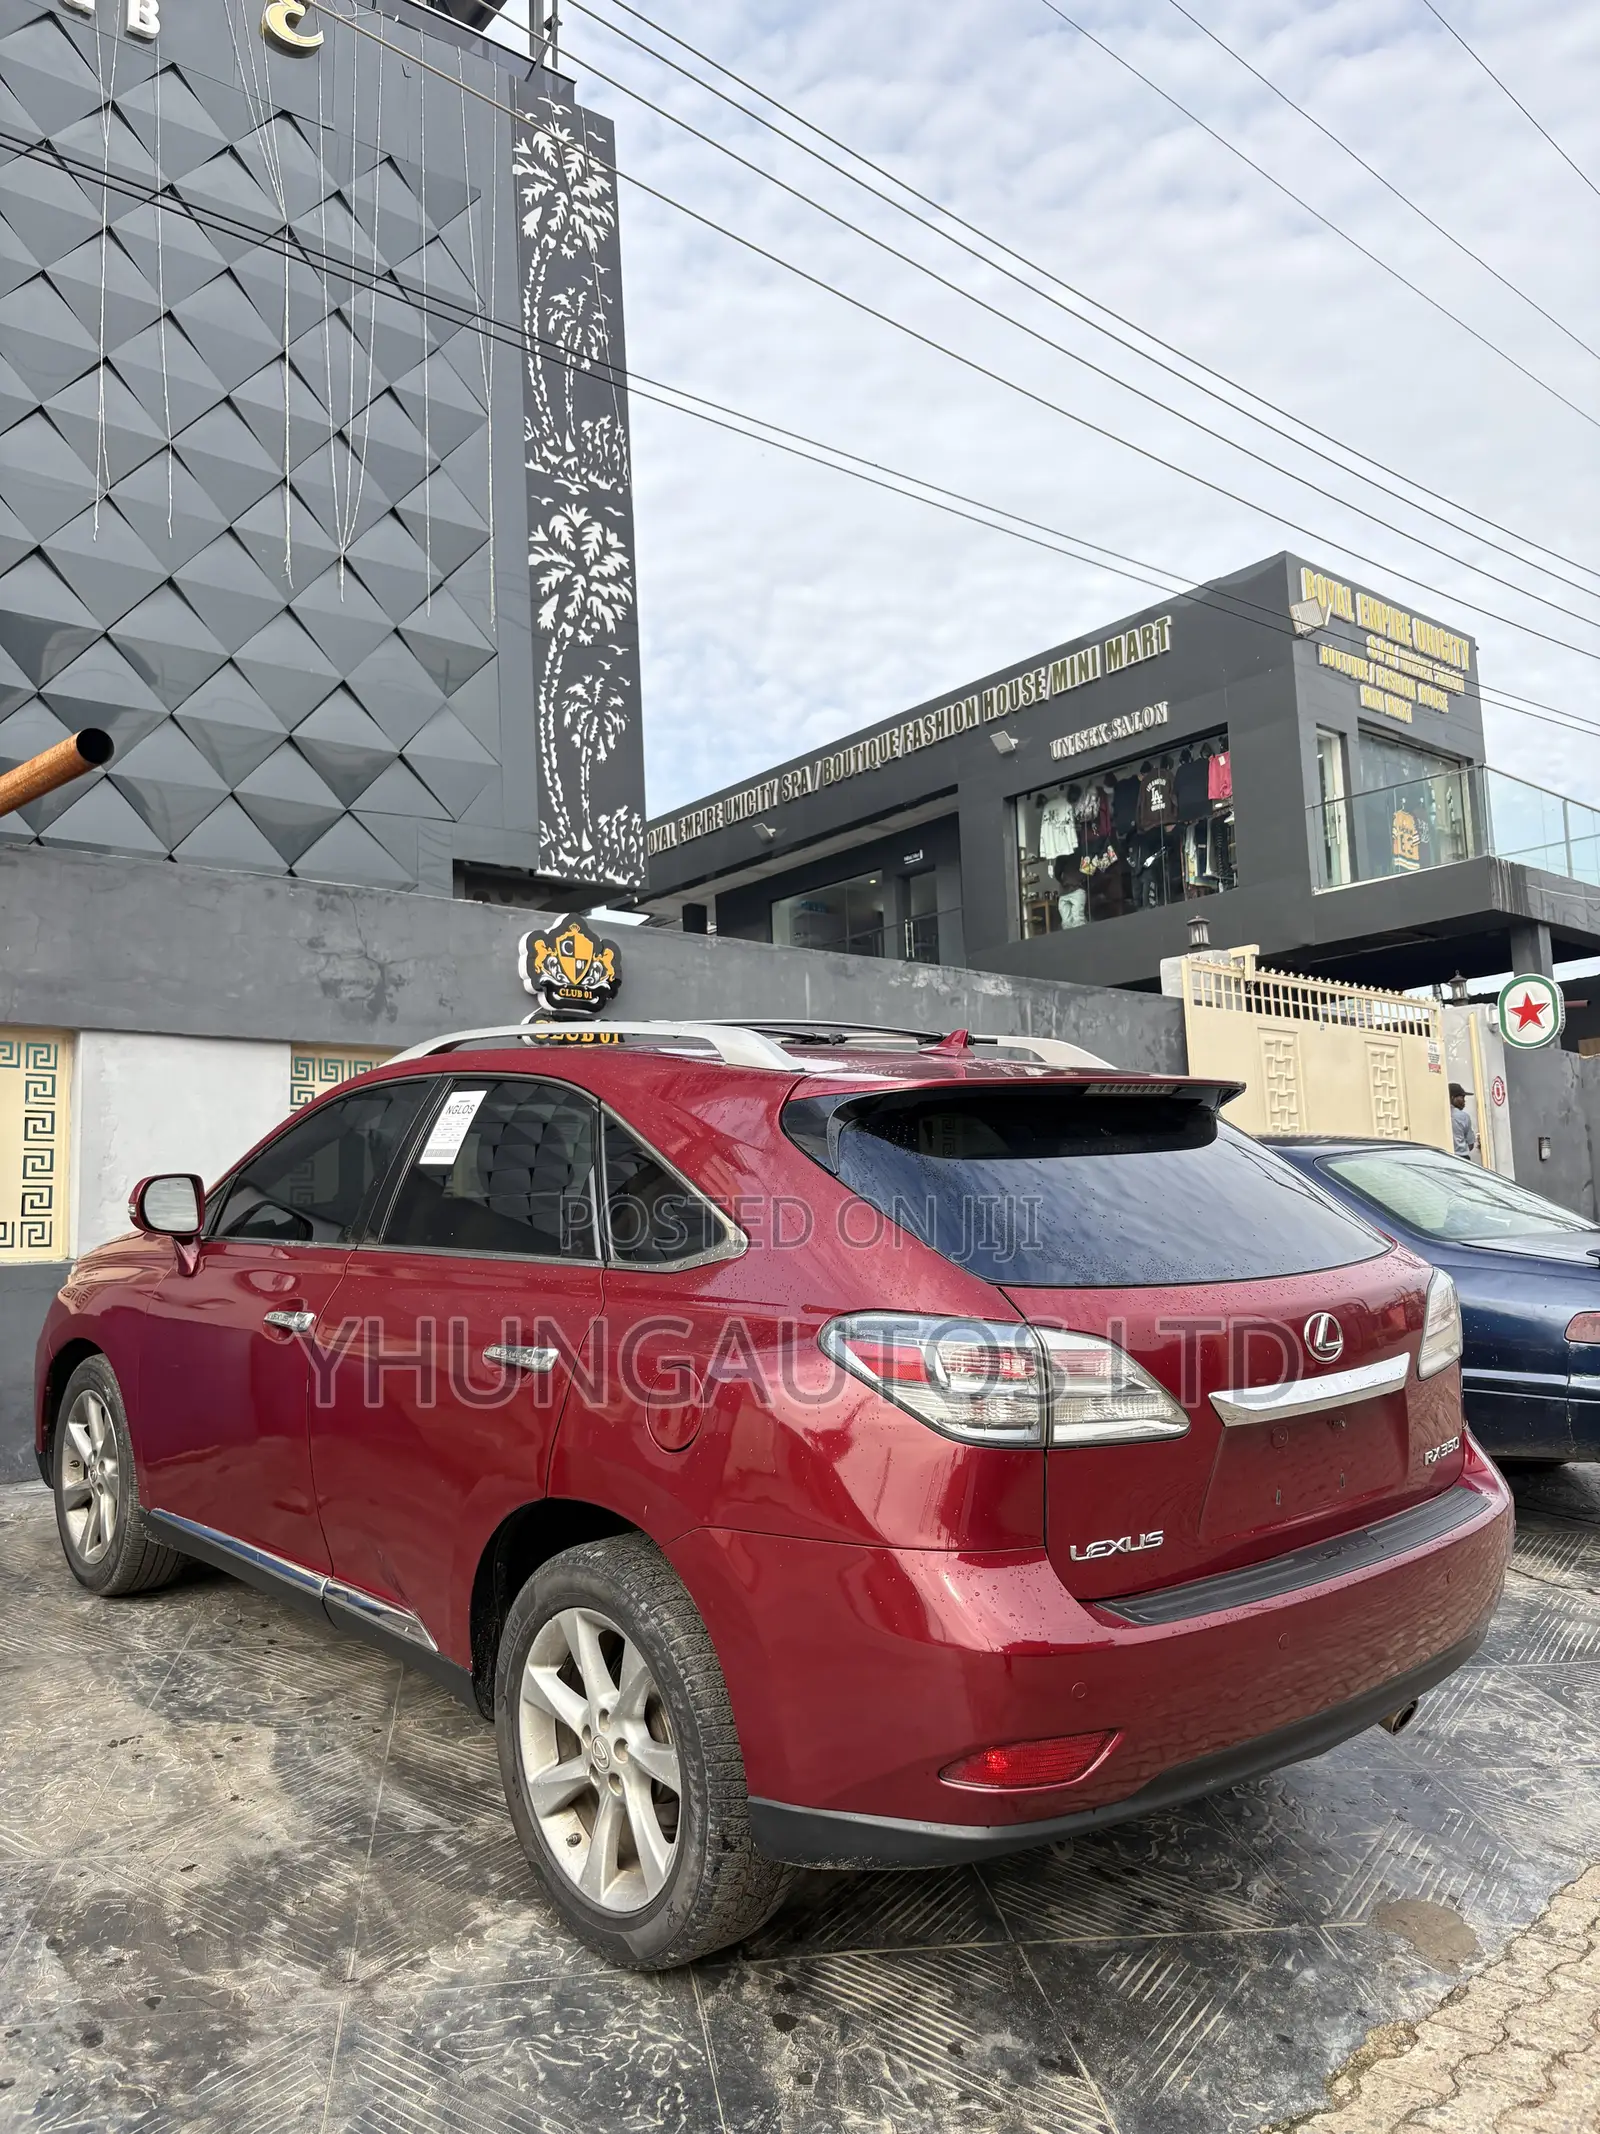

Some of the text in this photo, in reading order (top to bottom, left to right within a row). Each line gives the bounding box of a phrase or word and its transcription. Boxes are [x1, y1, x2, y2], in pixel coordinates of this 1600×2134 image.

[1301, 567, 1470, 672] ROYAL EMPIRE UNICITY
[647, 822, 677, 857] OYAL
[678, 802, 723, 844] EMPIRE
[723, 778, 779, 825] UNICITY
[1105, 615, 1172, 674] MART
[1050, 701, 1169, 761] UNISEX SALON
[561, 940, 573, 956] C
[559, 988, 593, 999] CLUB 01
[1069, 1530, 1164, 1561] LEXUS
